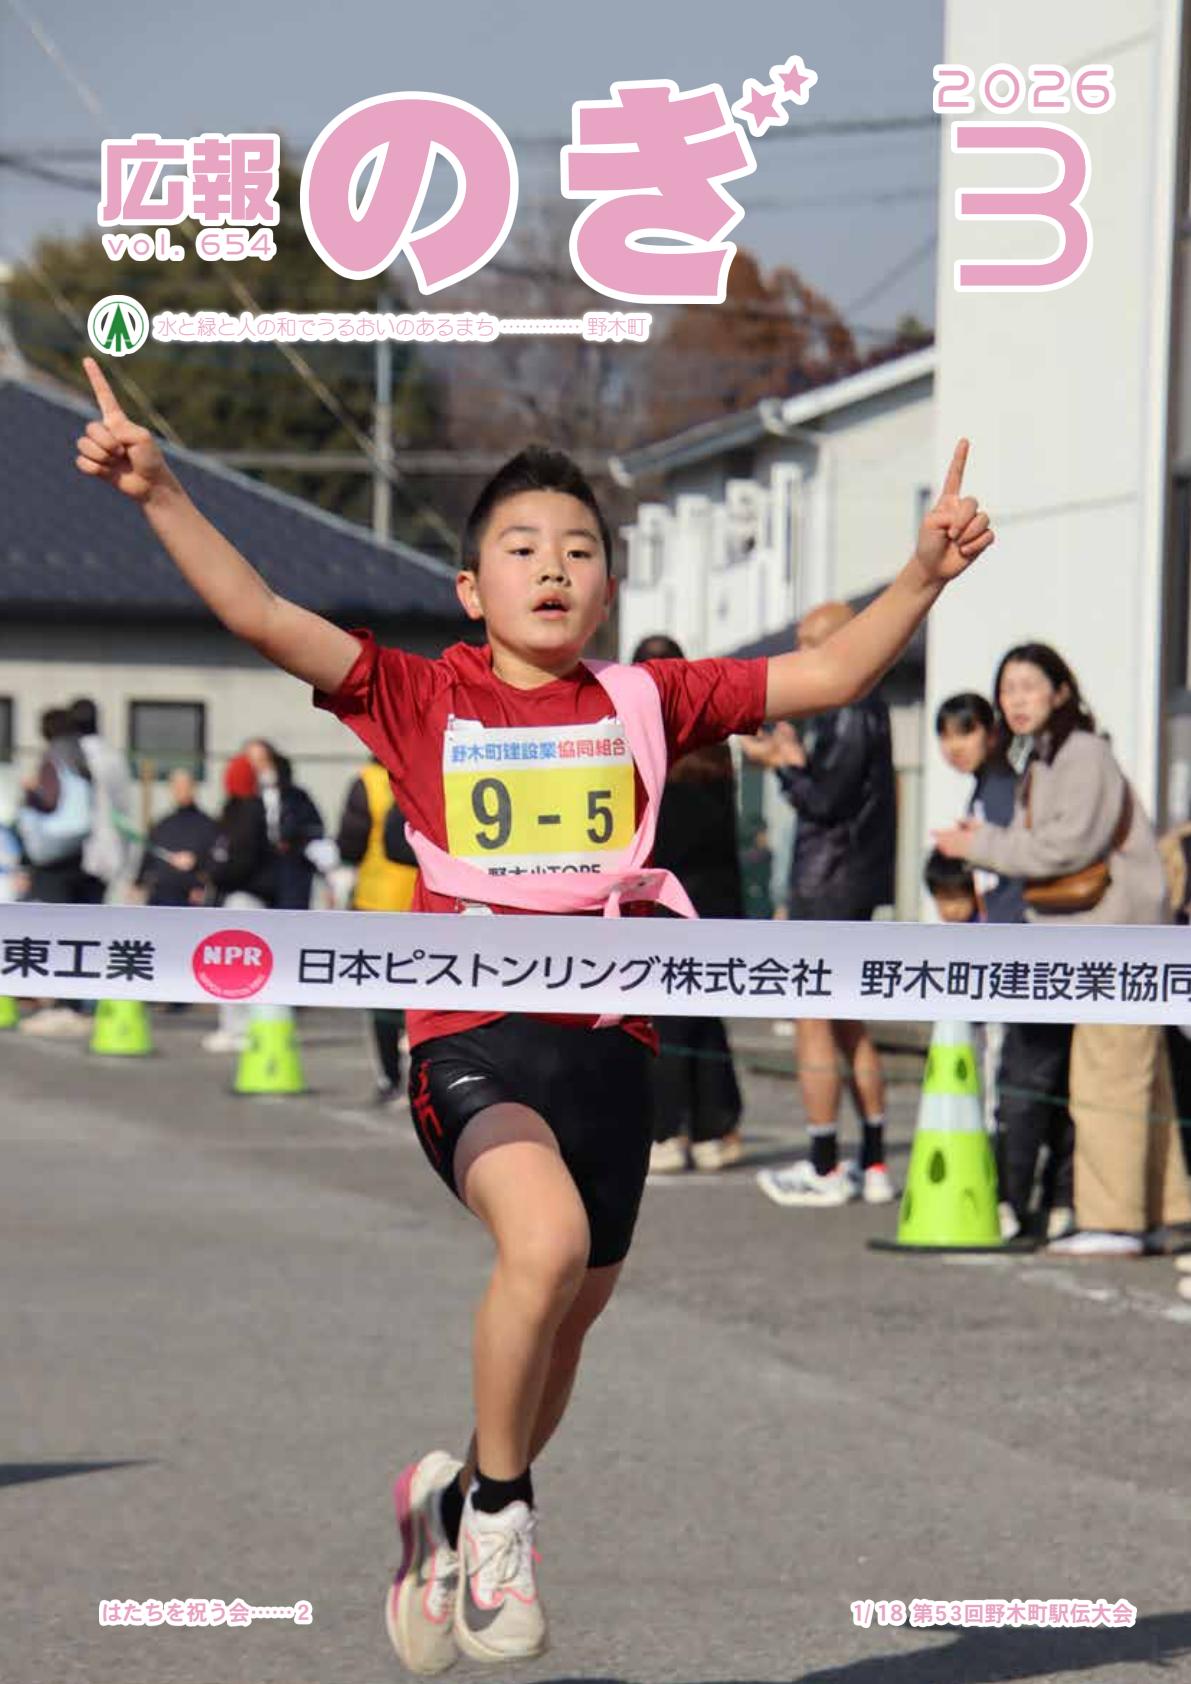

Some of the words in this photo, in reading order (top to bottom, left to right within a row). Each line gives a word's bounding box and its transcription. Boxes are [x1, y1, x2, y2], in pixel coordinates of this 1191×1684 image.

[471, 777, 512, 850] 9
[586, 790, 613, 845] 5
[203, 945, 262, 967] NPR
[298, 948, 833, 997] 日本ピストンリング株式会社
[860, 959, 1191, 1002] 野木町建設業協同
